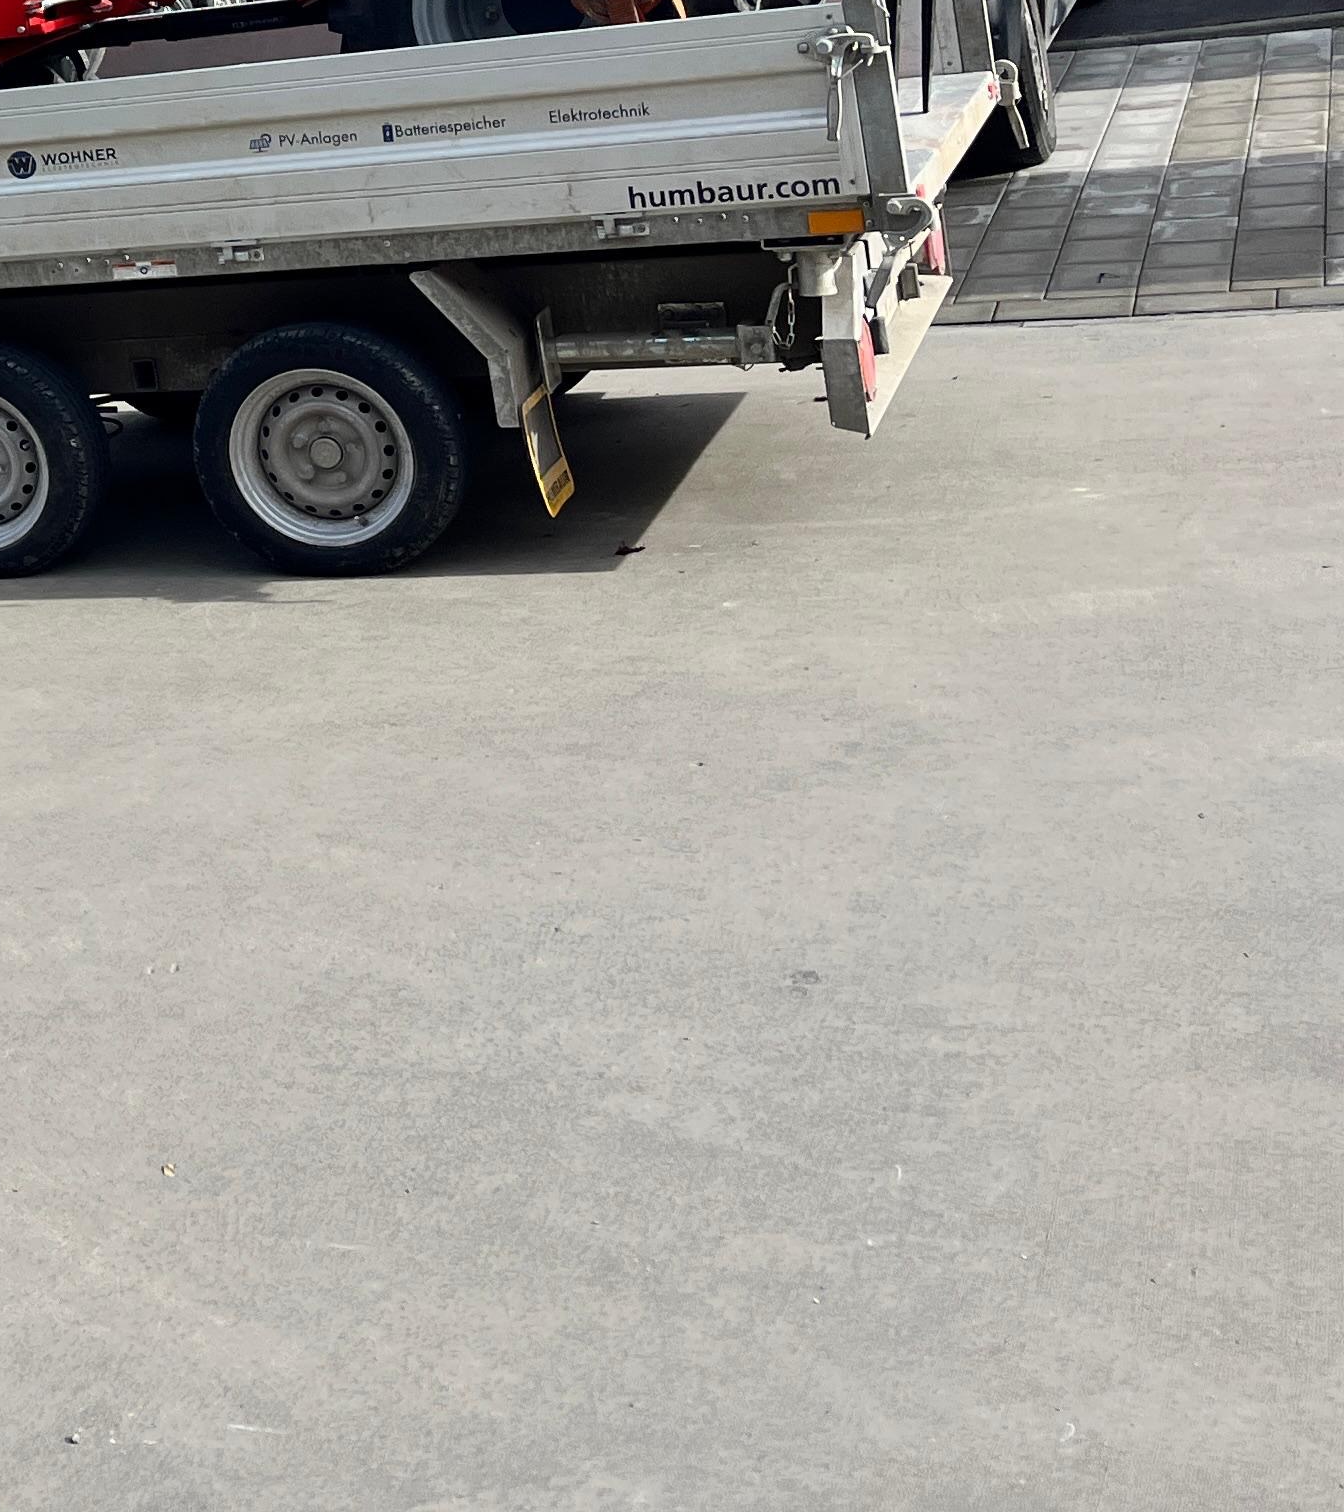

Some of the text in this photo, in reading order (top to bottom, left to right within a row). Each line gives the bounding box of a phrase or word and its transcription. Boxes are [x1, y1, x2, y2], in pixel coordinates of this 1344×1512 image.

[277, 102, 651, 147] PV-Anlagen Batteriespeicher Elektrotechnik
[40, 147, 117, 166] WOHNER
[627, 177, 841, 209] humbaur.com
